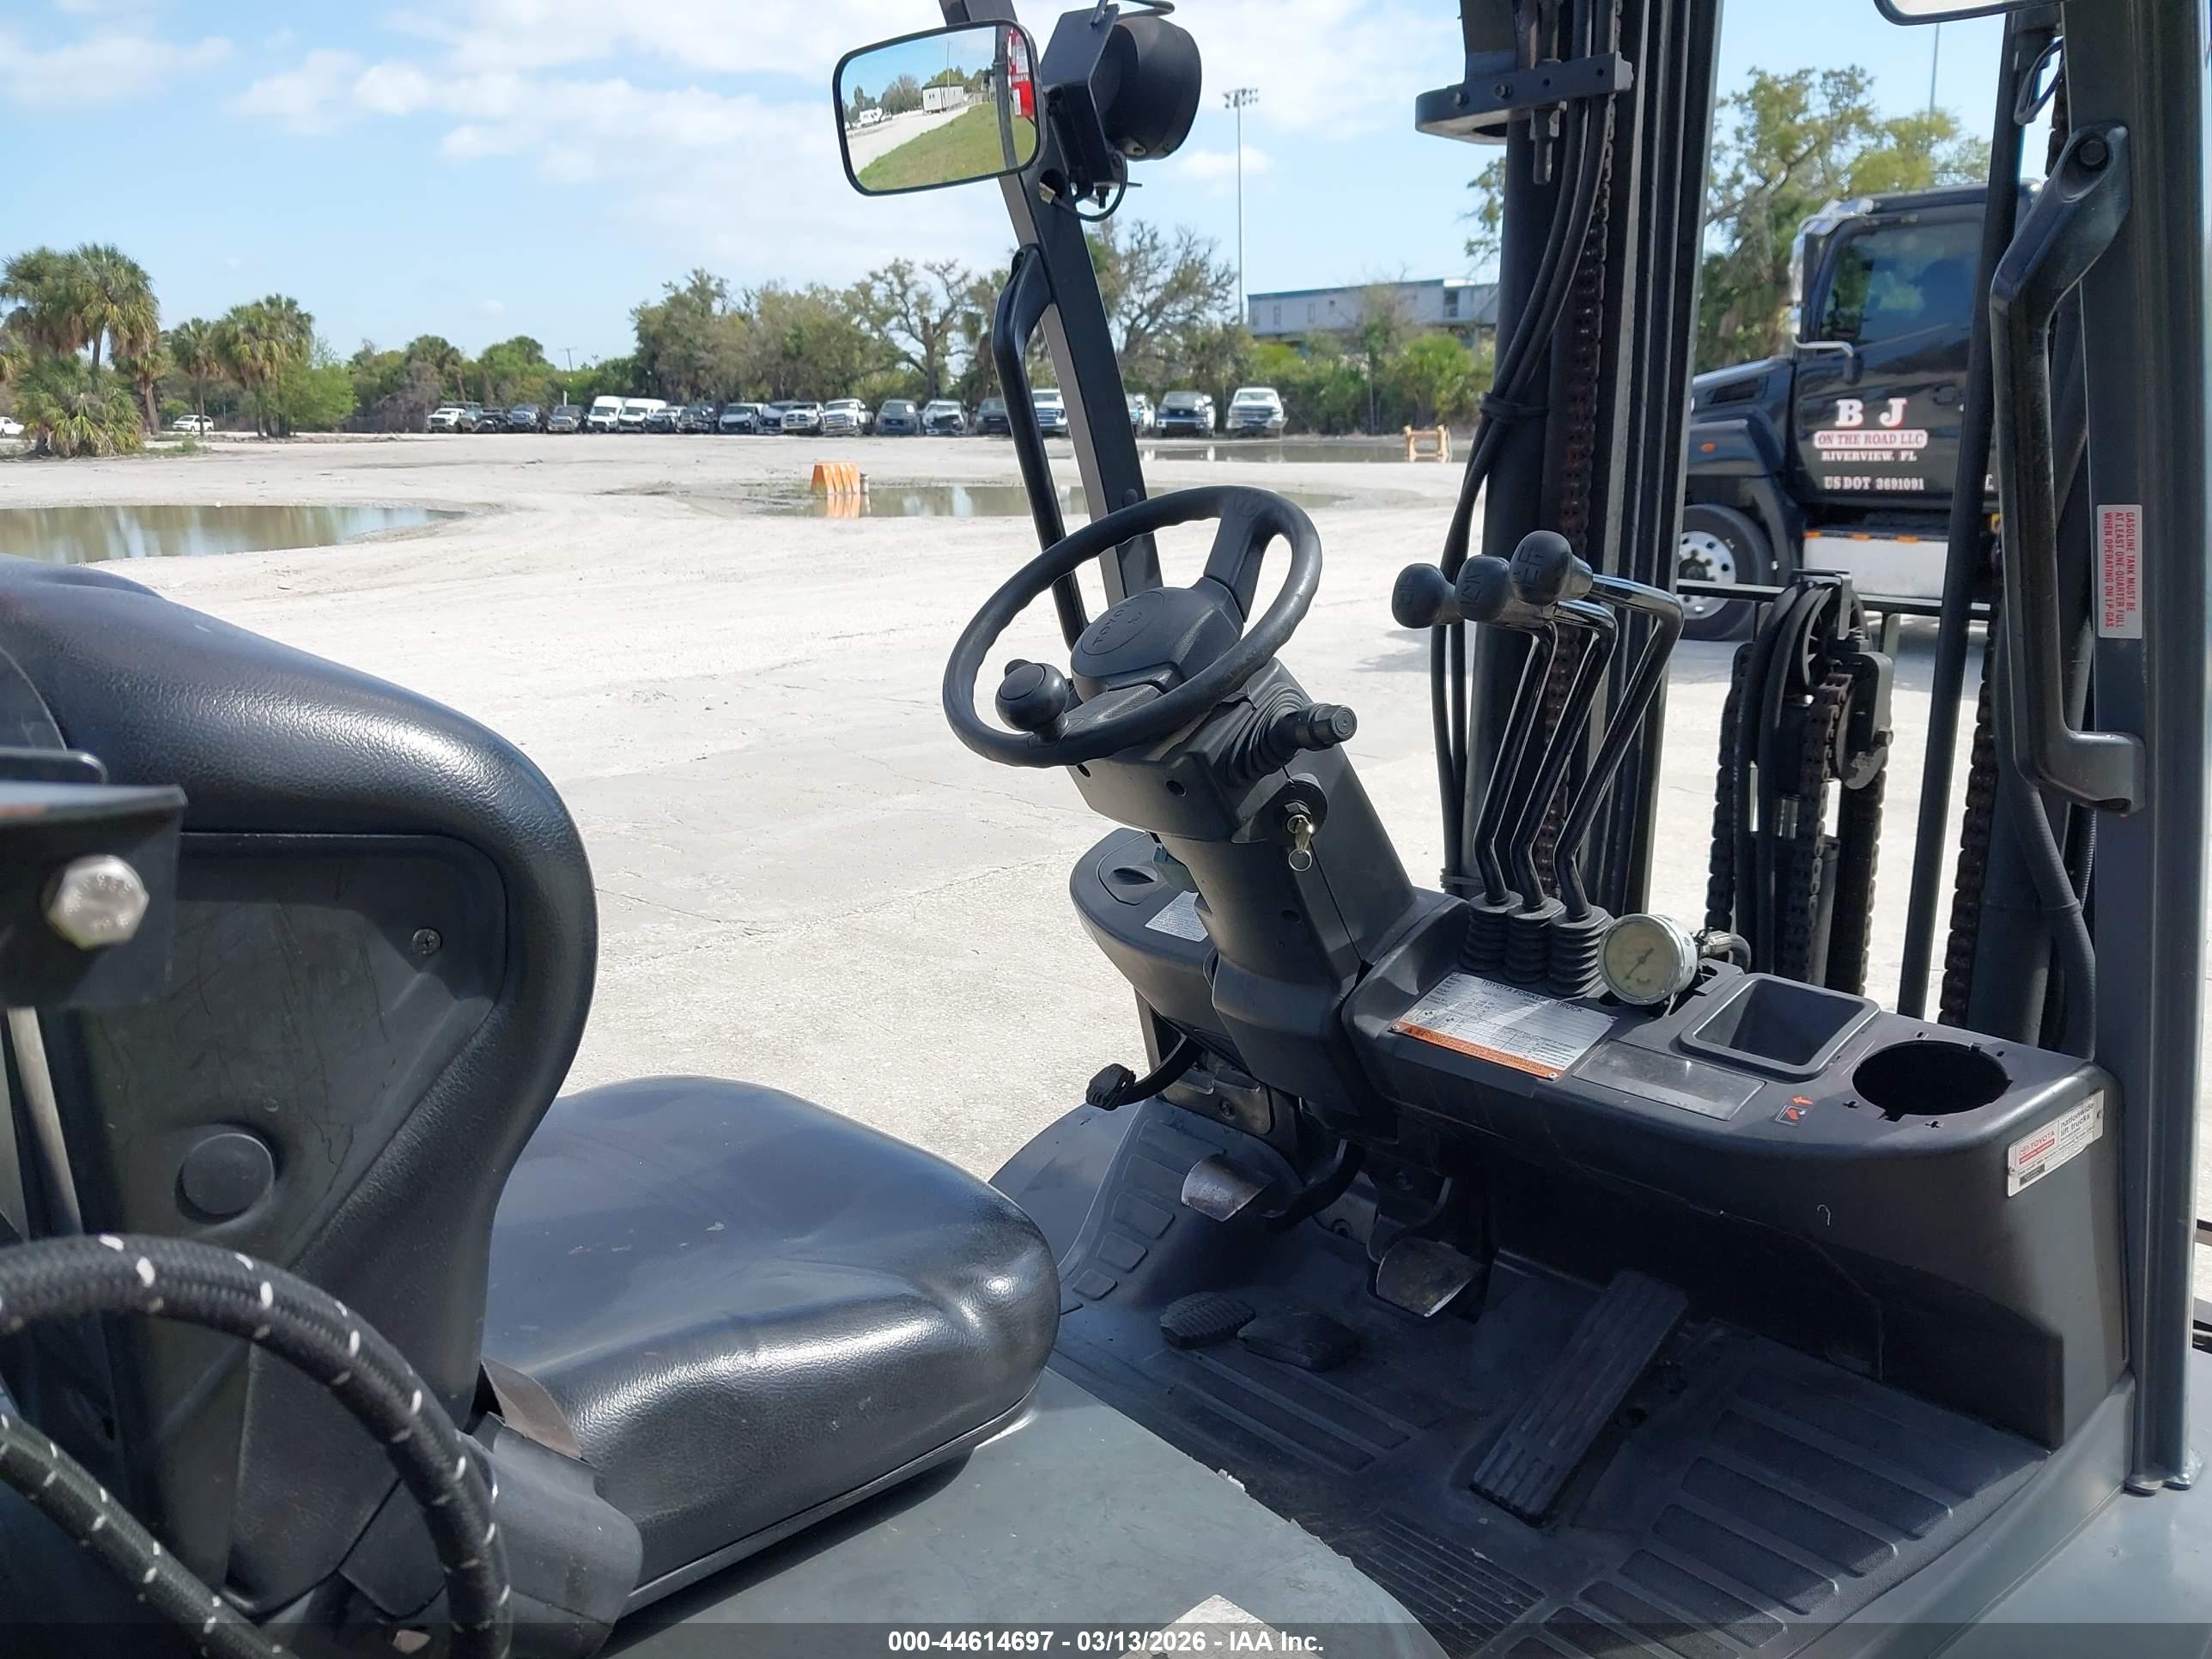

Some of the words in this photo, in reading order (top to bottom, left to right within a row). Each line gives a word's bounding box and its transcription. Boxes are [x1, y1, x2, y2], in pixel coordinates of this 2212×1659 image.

[1835, 398, 1863, 427] B
[1879, 398, 1908, 427] J
[1819, 434, 1833, 445] ON
[1838, 434, 1860, 445] THE
[1863, 434, 1898, 445] ROAD
[1900, 433, 1924, 445] LLC
[1899, 451, 1917, 461] FL
[2104, 512, 2113, 536] WHEN
[2115, 512, 2124, 521] AT
[2115, 524, 2124, 549] LEAST
[2126, 512, 2135, 551] GASOLINE
[2105, 538, 2113, 583] OPERATING
[2116, 552, 2124, 607] ONE-QUARTER
[2127, 577, 2136, 599] MUST
[2106, 586, 2114, 597] ON
[2106, 599, 2114, 628] LP-GAS
[2127, 602, 2136, 612] BE
[2116, 609, 2124, 629] FULL
[1482, 980, 1512, 992] TOYOTA
[1554, 1000, 1584, 1013] TRUCK
[2071, 1113, 2091, 1132] trucks
[2030, 1130, 2055, 1149] TOYOTA
